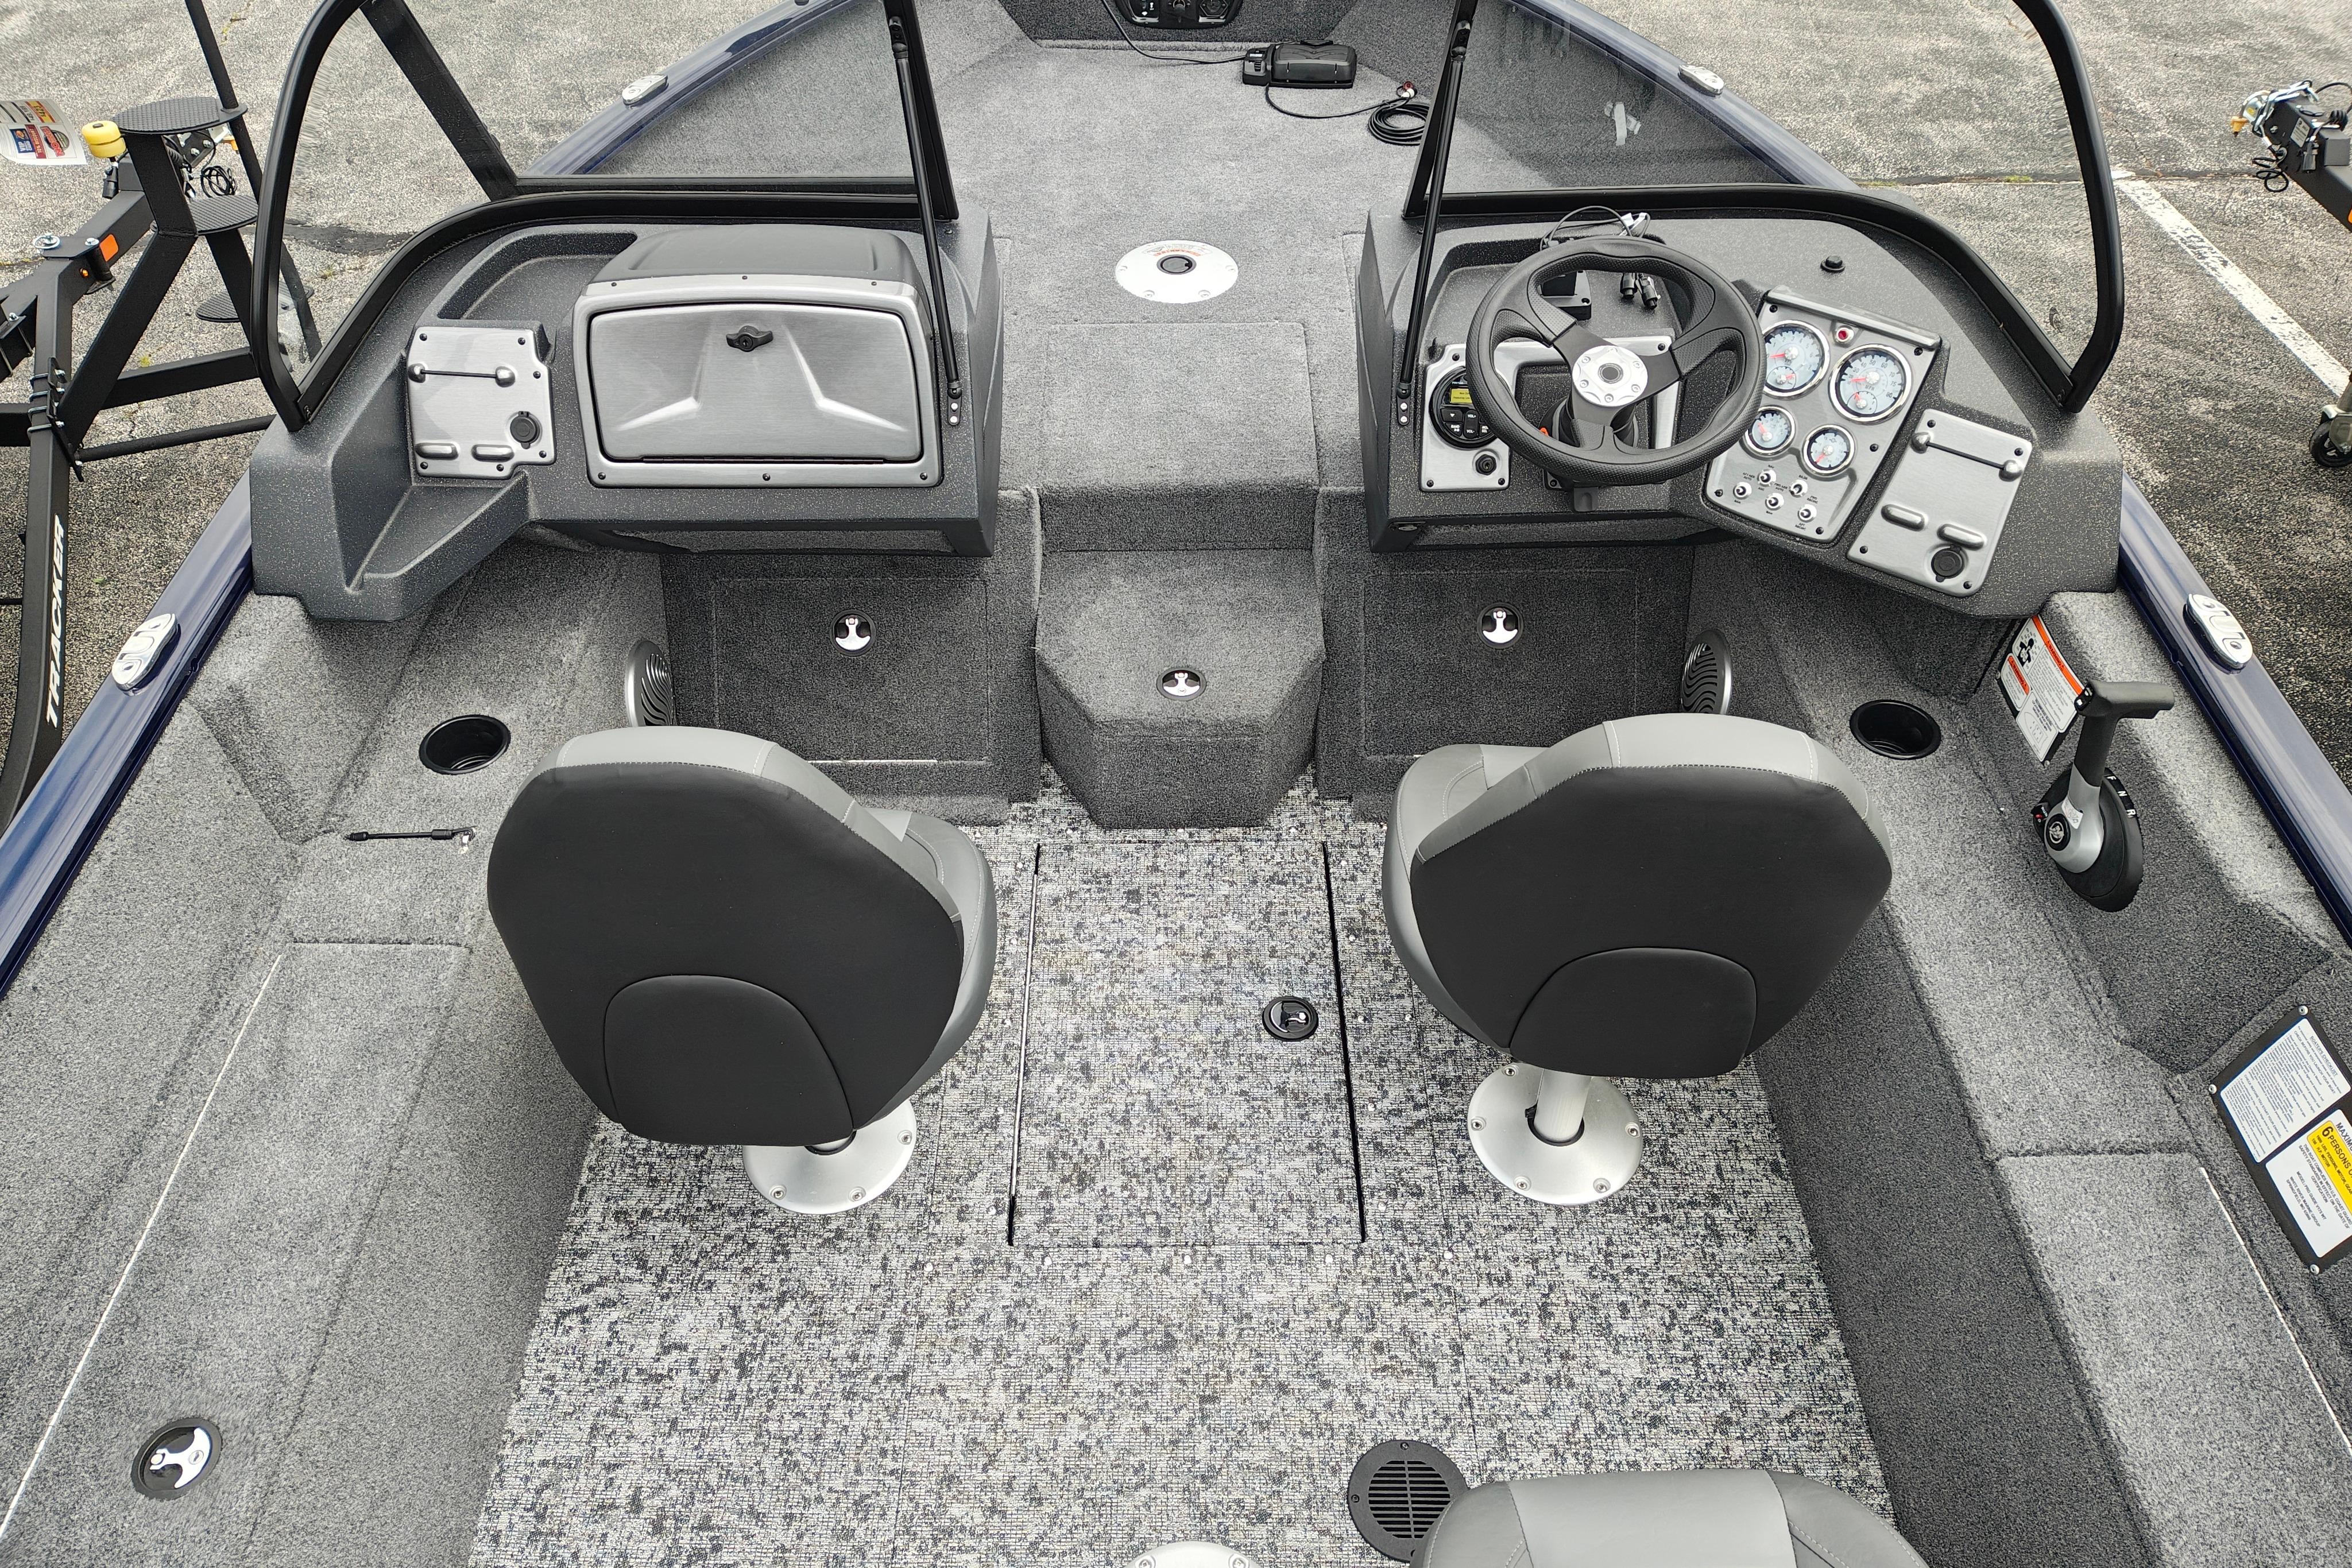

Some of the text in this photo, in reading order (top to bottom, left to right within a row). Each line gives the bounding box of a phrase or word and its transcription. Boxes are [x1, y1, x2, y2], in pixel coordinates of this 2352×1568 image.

[46, 514, 64, 728] TRACKER
[2127, 809, 2136, 818] R
[2293, 1030, 2302, 1042] CHECK
[2300, 1042, 2310, 1055] BEFORE
[2310, 1035, 2338, 1077] BOATER'S CHECKLIST
[2320, 1154, 2331, 1168] MOTOR
[2322, 1126, 2334, 1137] 6
[2328, 1135, 2351, 1169] PERSONS
[2298, 1144, 2308, 1159] SAFETY
[2306, 1158, 2321, 1180] STANDARDS
[2321, 1184, 2332, 1199] EFFECT
[2338, 1213, 2346, 1224] DATE
[2303, 1144, 2311, 1153] THIS
[2307, 1152, 2316, 1163] BOAT
[2314, 1162, 2327, 1181] COMPLIES
[2324, 1180, 2332, 1191] WITH
[2334, 1198, 2345, 1211] COAST
[2342, 1210, 2352, 1225] GUARD
[2326, 1152, 2338, 1171] PERSONS,
[2337, 1169, 2346, 1185] MOTOR,
[2285, 1179, 2301, 1203] SPRINGFIELD,
[2289, 1176, 2320, 1228] WHITE RIVER MARINE GROUP
[2296, 1171, 2306, 1186] MODEL:
[2308, 1193, 2318, 1205] GUIDE
[2310, 1175, 2328, 1203] CERTIFICATION
